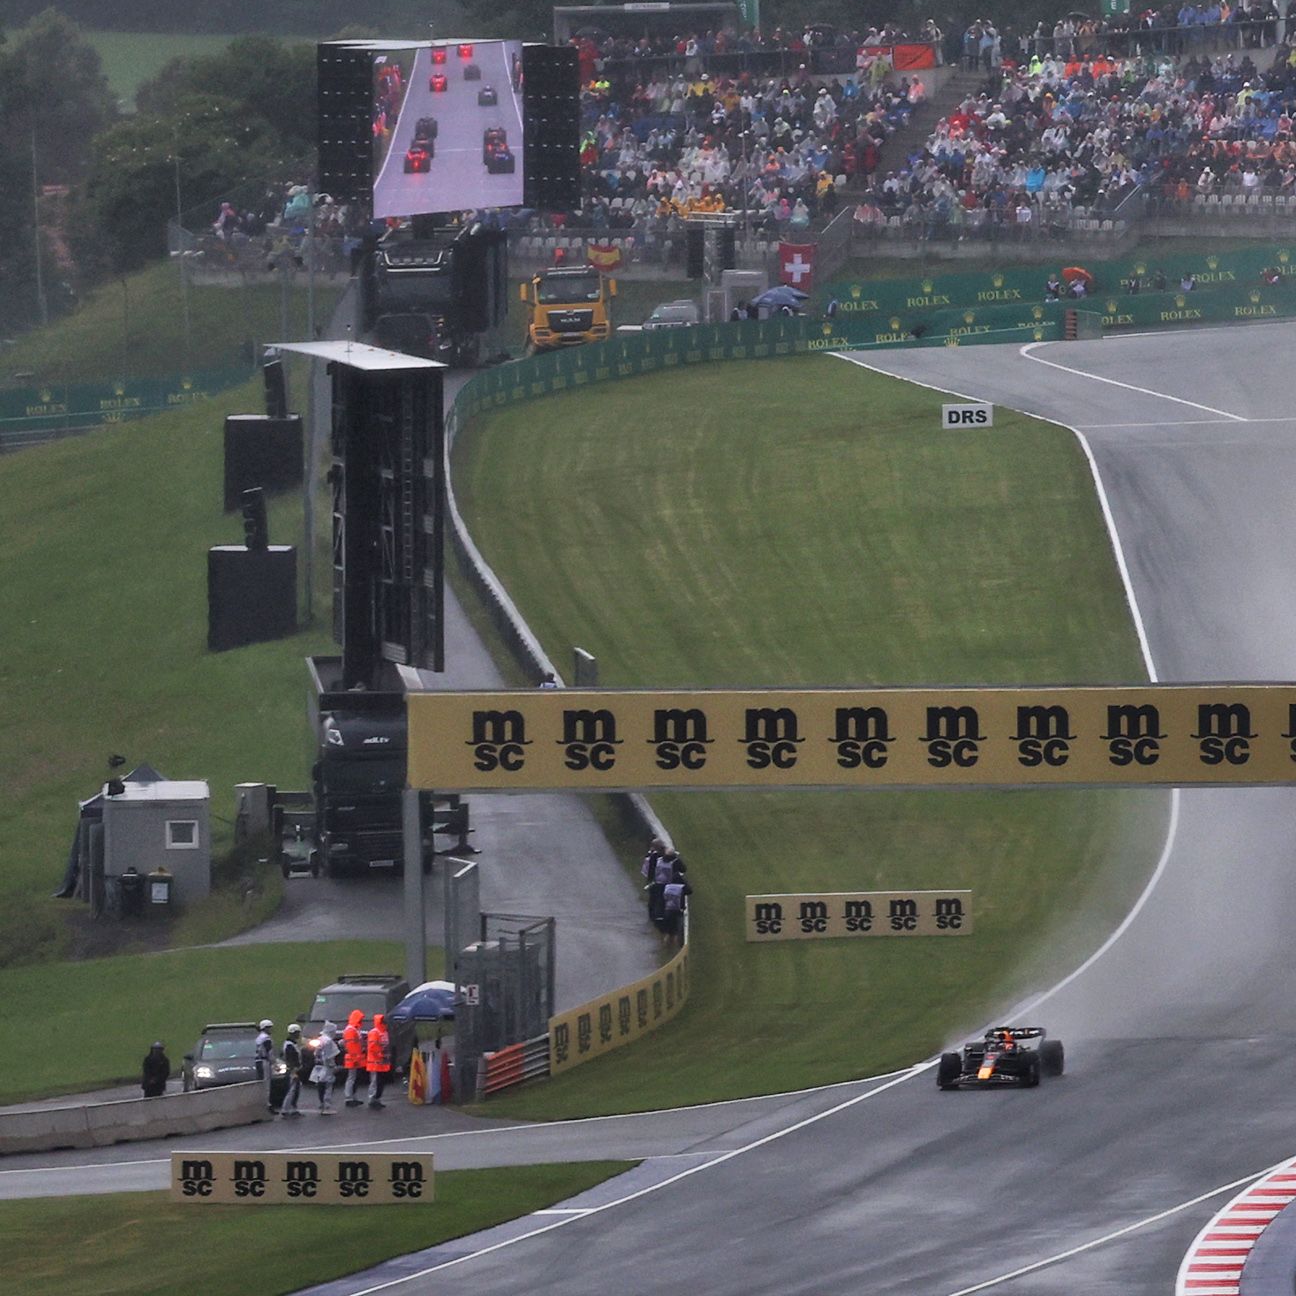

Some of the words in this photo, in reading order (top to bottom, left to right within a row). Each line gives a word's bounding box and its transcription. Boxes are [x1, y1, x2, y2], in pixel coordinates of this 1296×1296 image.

[907, 295, 950, 307] ROLEX
[977, 290, 1021, 301] ROLEX
[1160, 309, 1201, 321] ROLEX
[1235, 305, 1276, 316] ROLEX
[1102, 314, 1133, 325] OLEX
[808, 337, 848, 349] ROLEX
[948, 410, 987, 424] DRS
